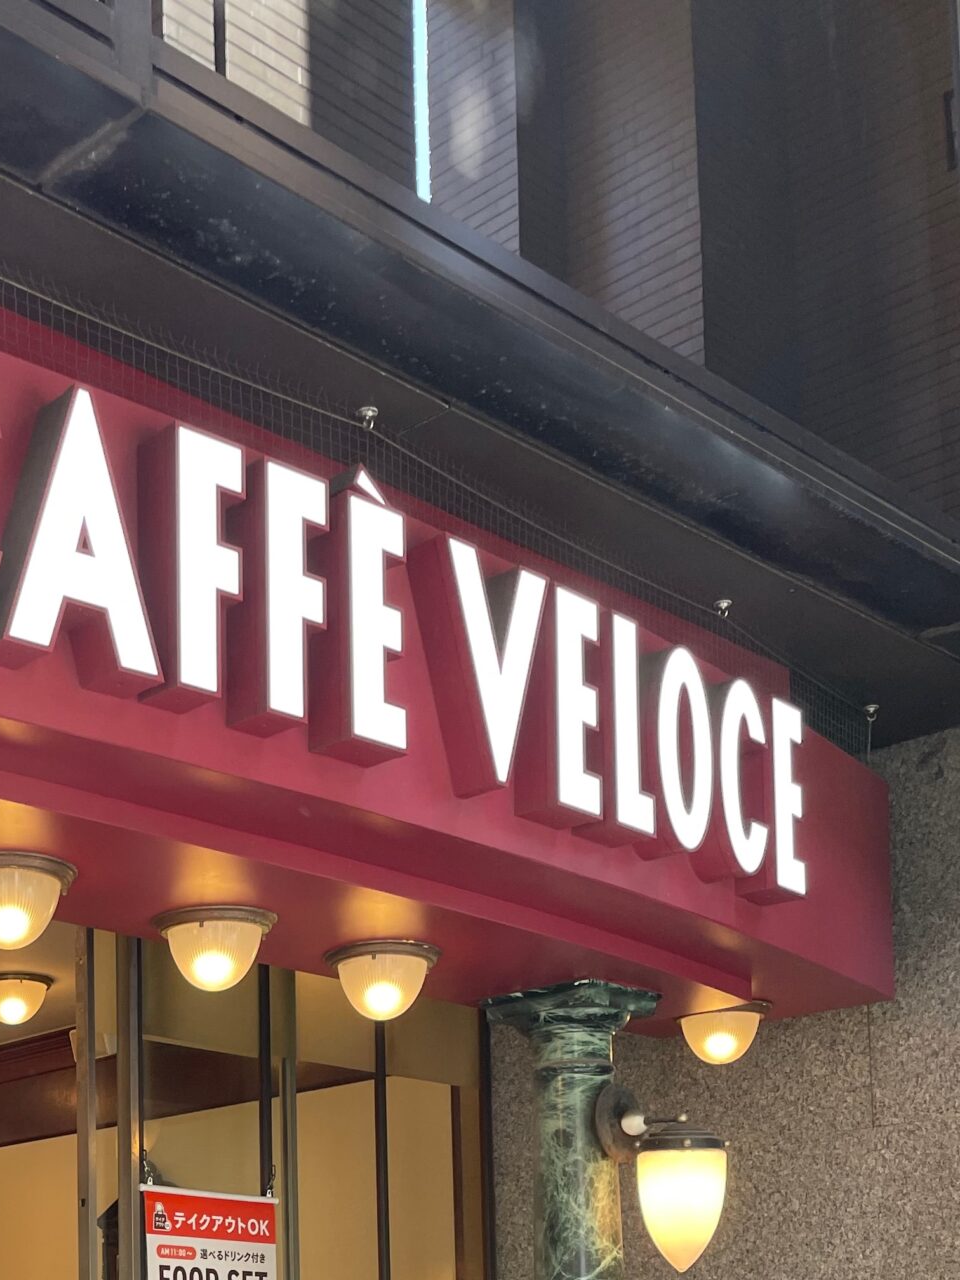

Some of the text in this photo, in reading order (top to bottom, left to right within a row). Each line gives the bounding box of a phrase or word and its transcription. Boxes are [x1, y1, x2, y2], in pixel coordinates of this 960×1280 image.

[447, 536, 808, 897] VELOCE
[173, 1211, 270, 1237] テイクアウトOK
[200, 1248, 266, 1264] 選べるドリンク付き
